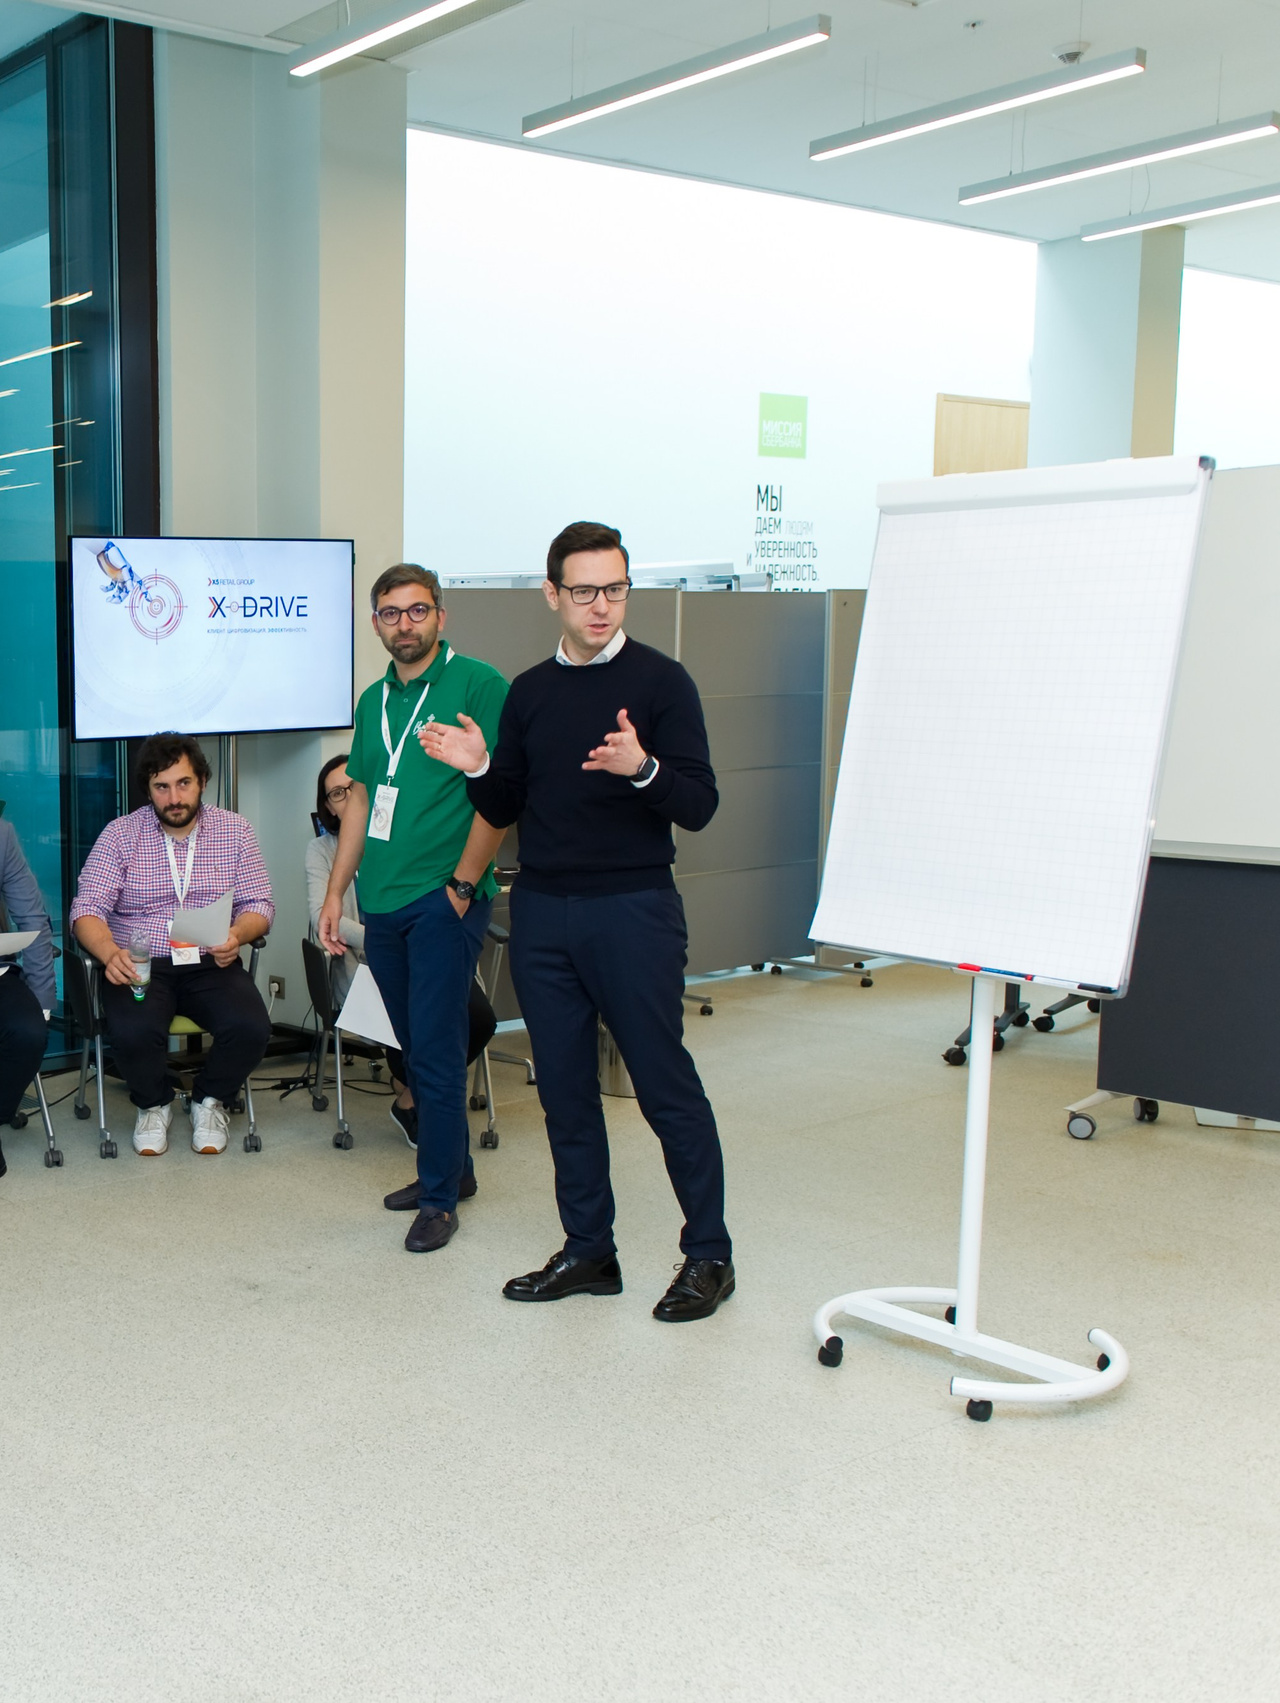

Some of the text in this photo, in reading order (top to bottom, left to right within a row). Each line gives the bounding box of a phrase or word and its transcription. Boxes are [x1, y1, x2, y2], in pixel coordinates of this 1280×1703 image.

[762, 420, 803, 437] МИССИЯ
[756, 484, 782, 512] МЫ
[755, 516, 782, 537] ДАЕМ
[755, 540, 818, 559] УВЕРЕННОСТЬ
[746, 553, 752, 567] И
